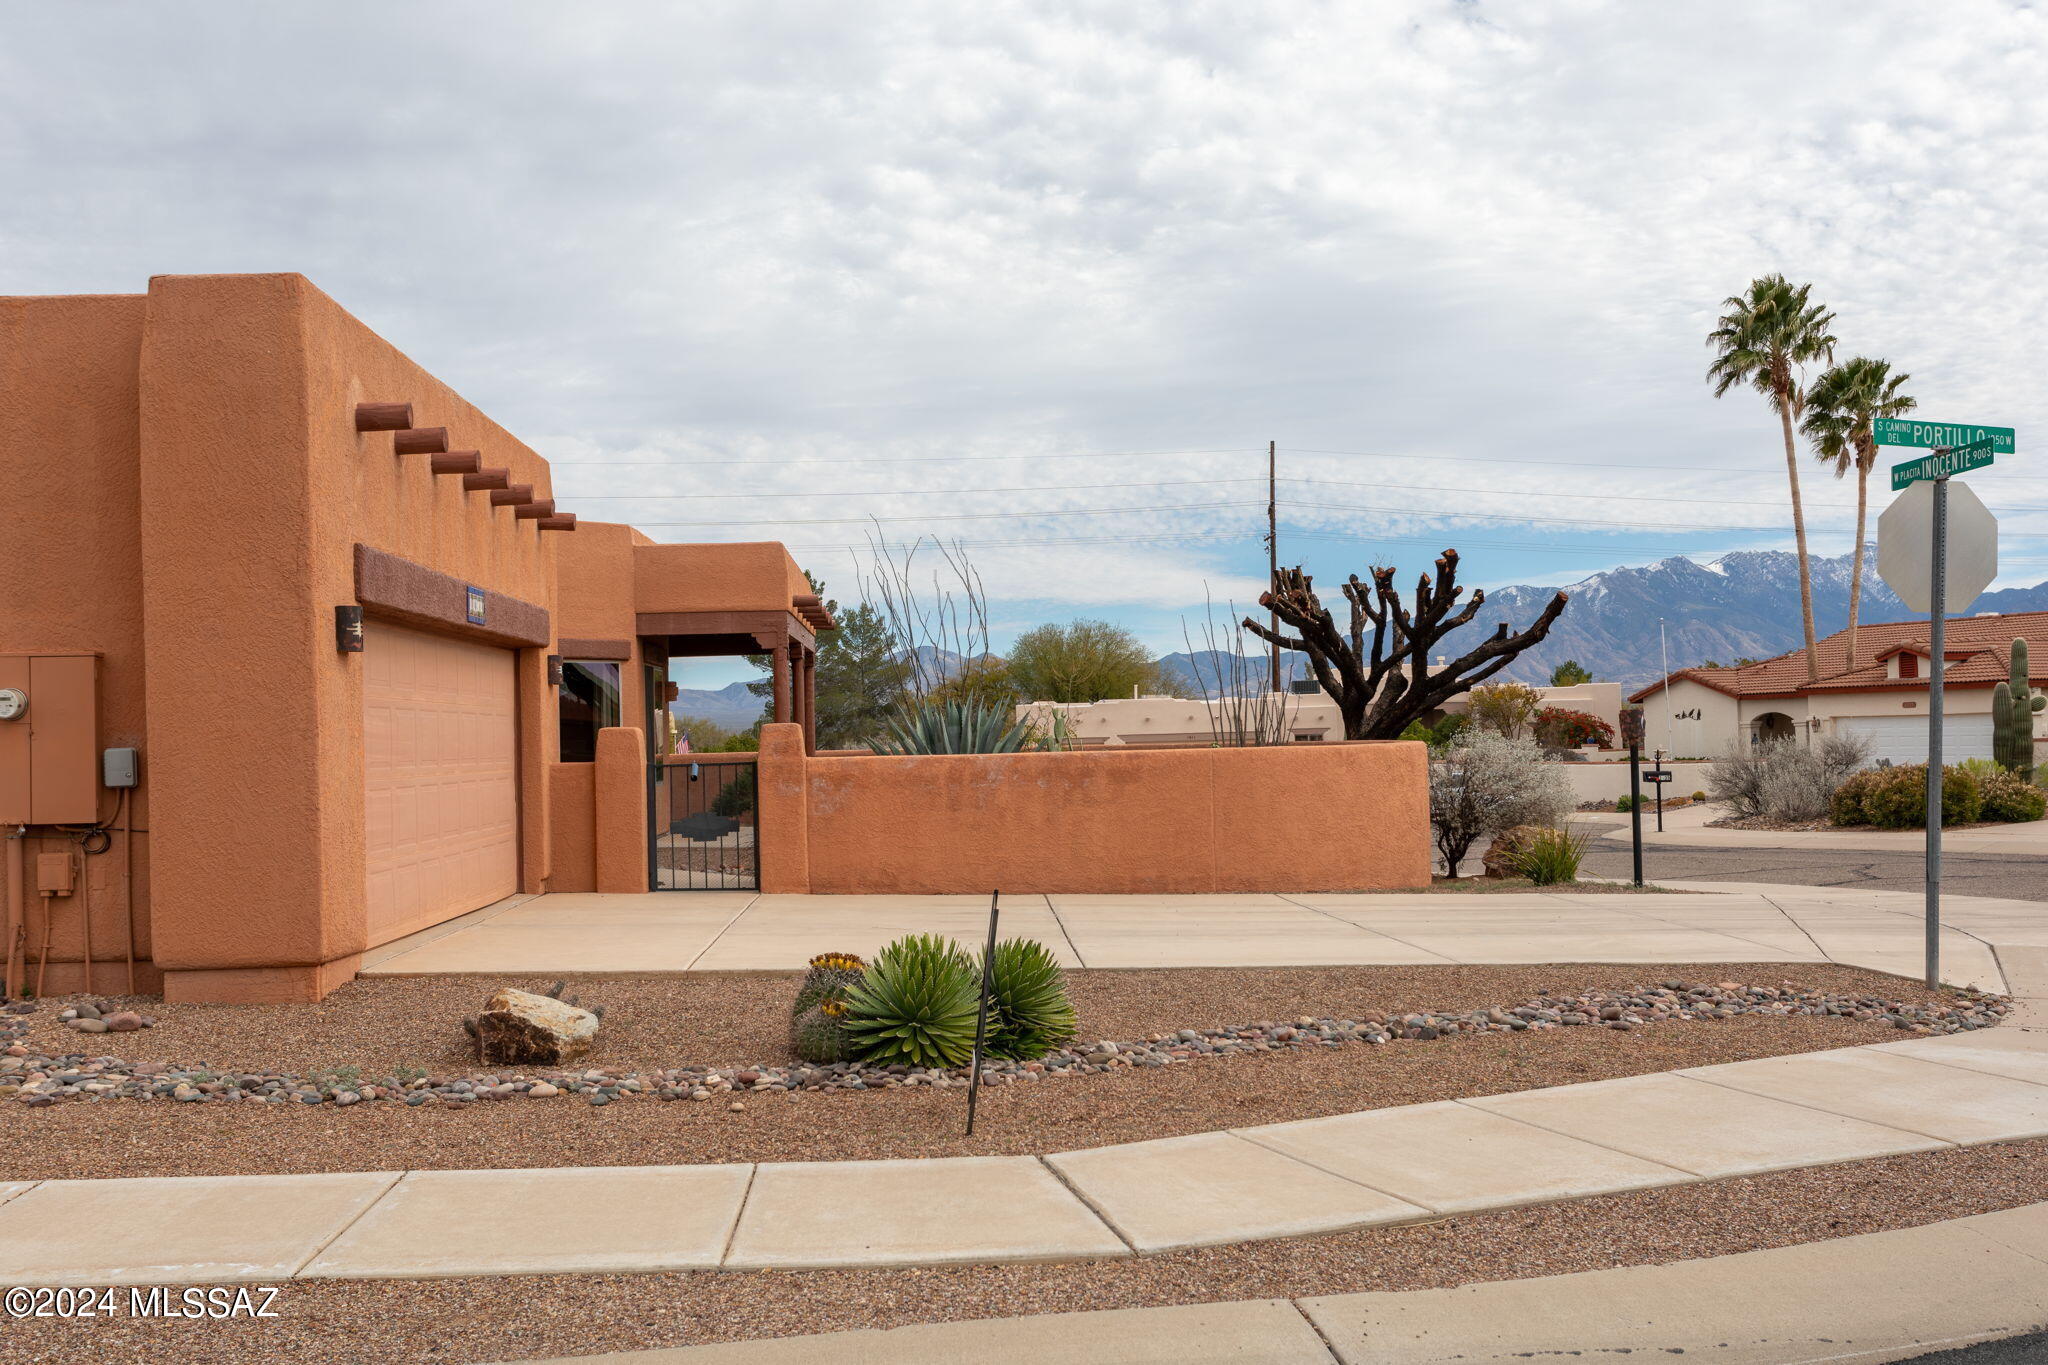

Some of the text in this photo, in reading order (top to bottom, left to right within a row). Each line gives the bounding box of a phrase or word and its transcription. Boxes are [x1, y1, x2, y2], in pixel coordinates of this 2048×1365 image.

[1878, 421, 1912, 433] S CAMINO
[1887, 433, 1901, 443] DEL
[1913, 425, 1986, 446] PORTILLO
[1922, 447, 1971, 480] INOCENTE
[1894, 467, 1921, 483] W PLACITA
